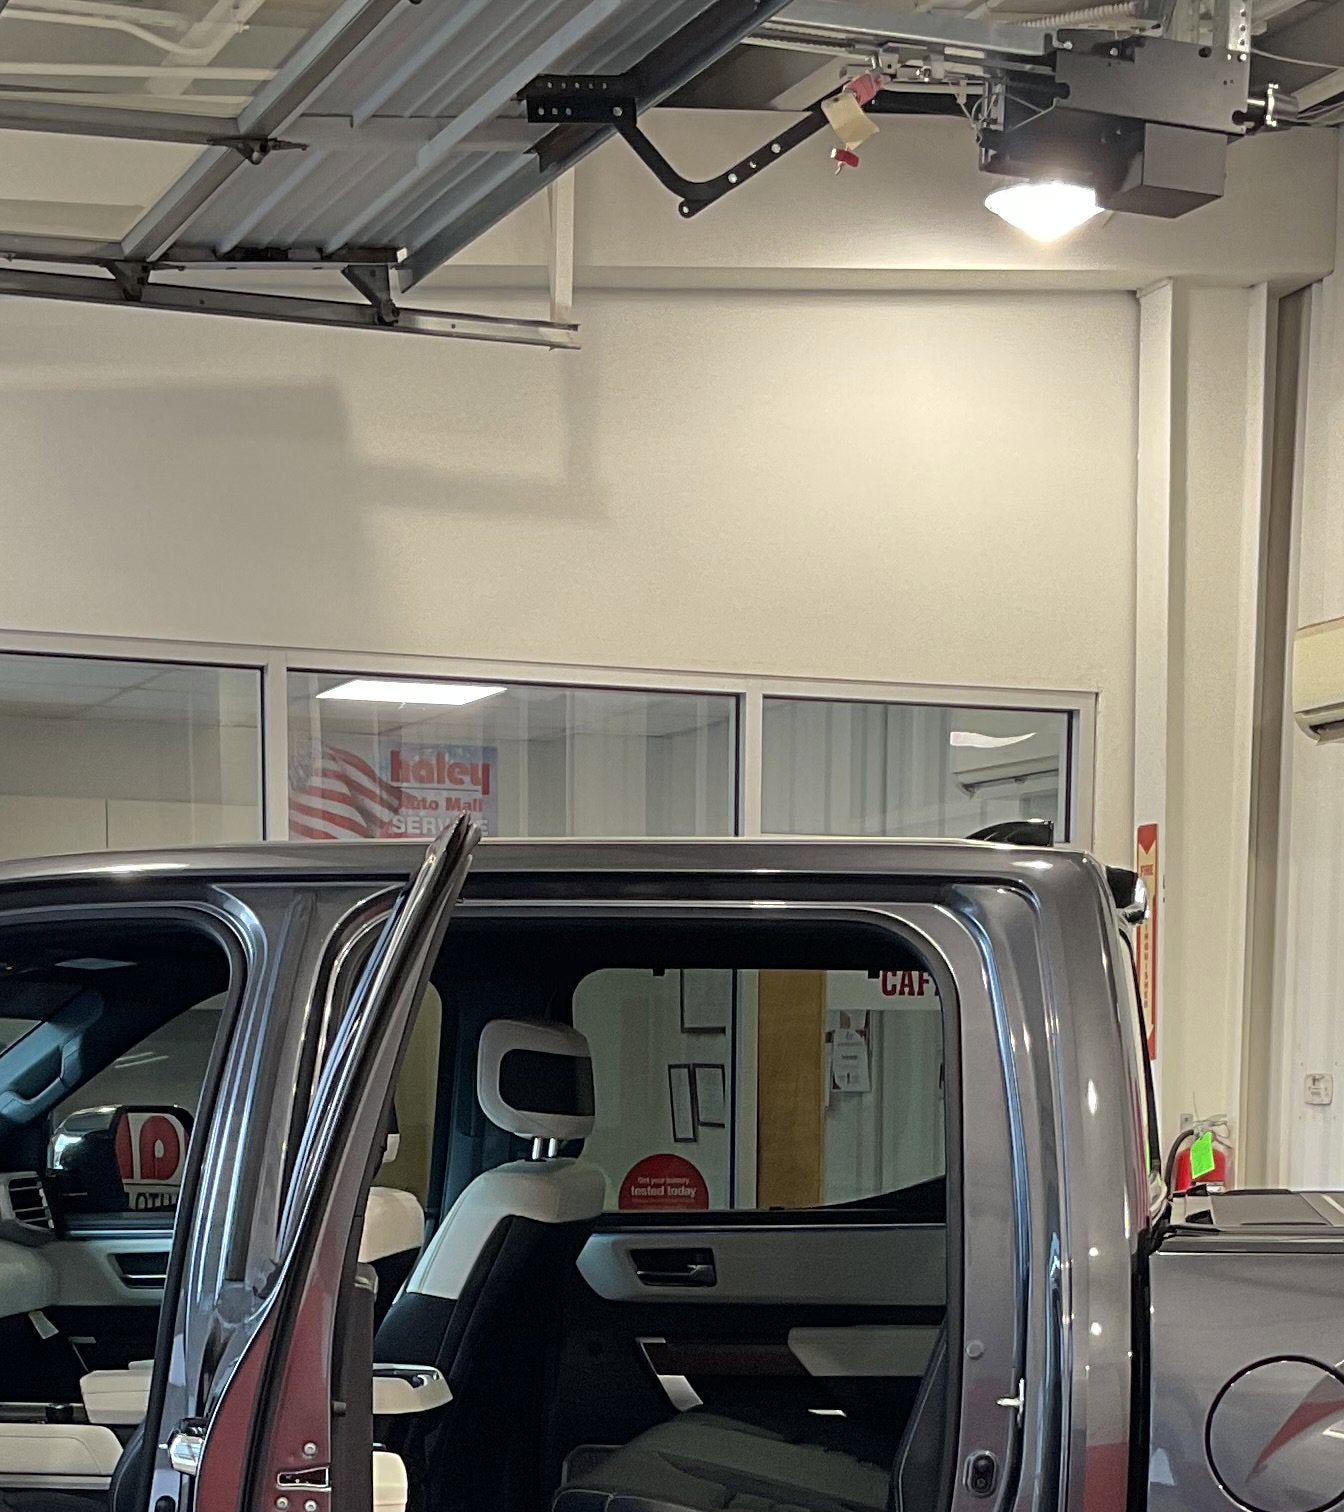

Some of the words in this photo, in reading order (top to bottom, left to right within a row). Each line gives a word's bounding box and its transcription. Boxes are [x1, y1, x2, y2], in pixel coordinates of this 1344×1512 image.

[390, 750, 489, 795] haley
[445, 797, 482, 813] Mall
[881, 970, 939, 996] CAF
[631, 1185, 665, 1196] tested
[667, 1185, 697, 1198] today
